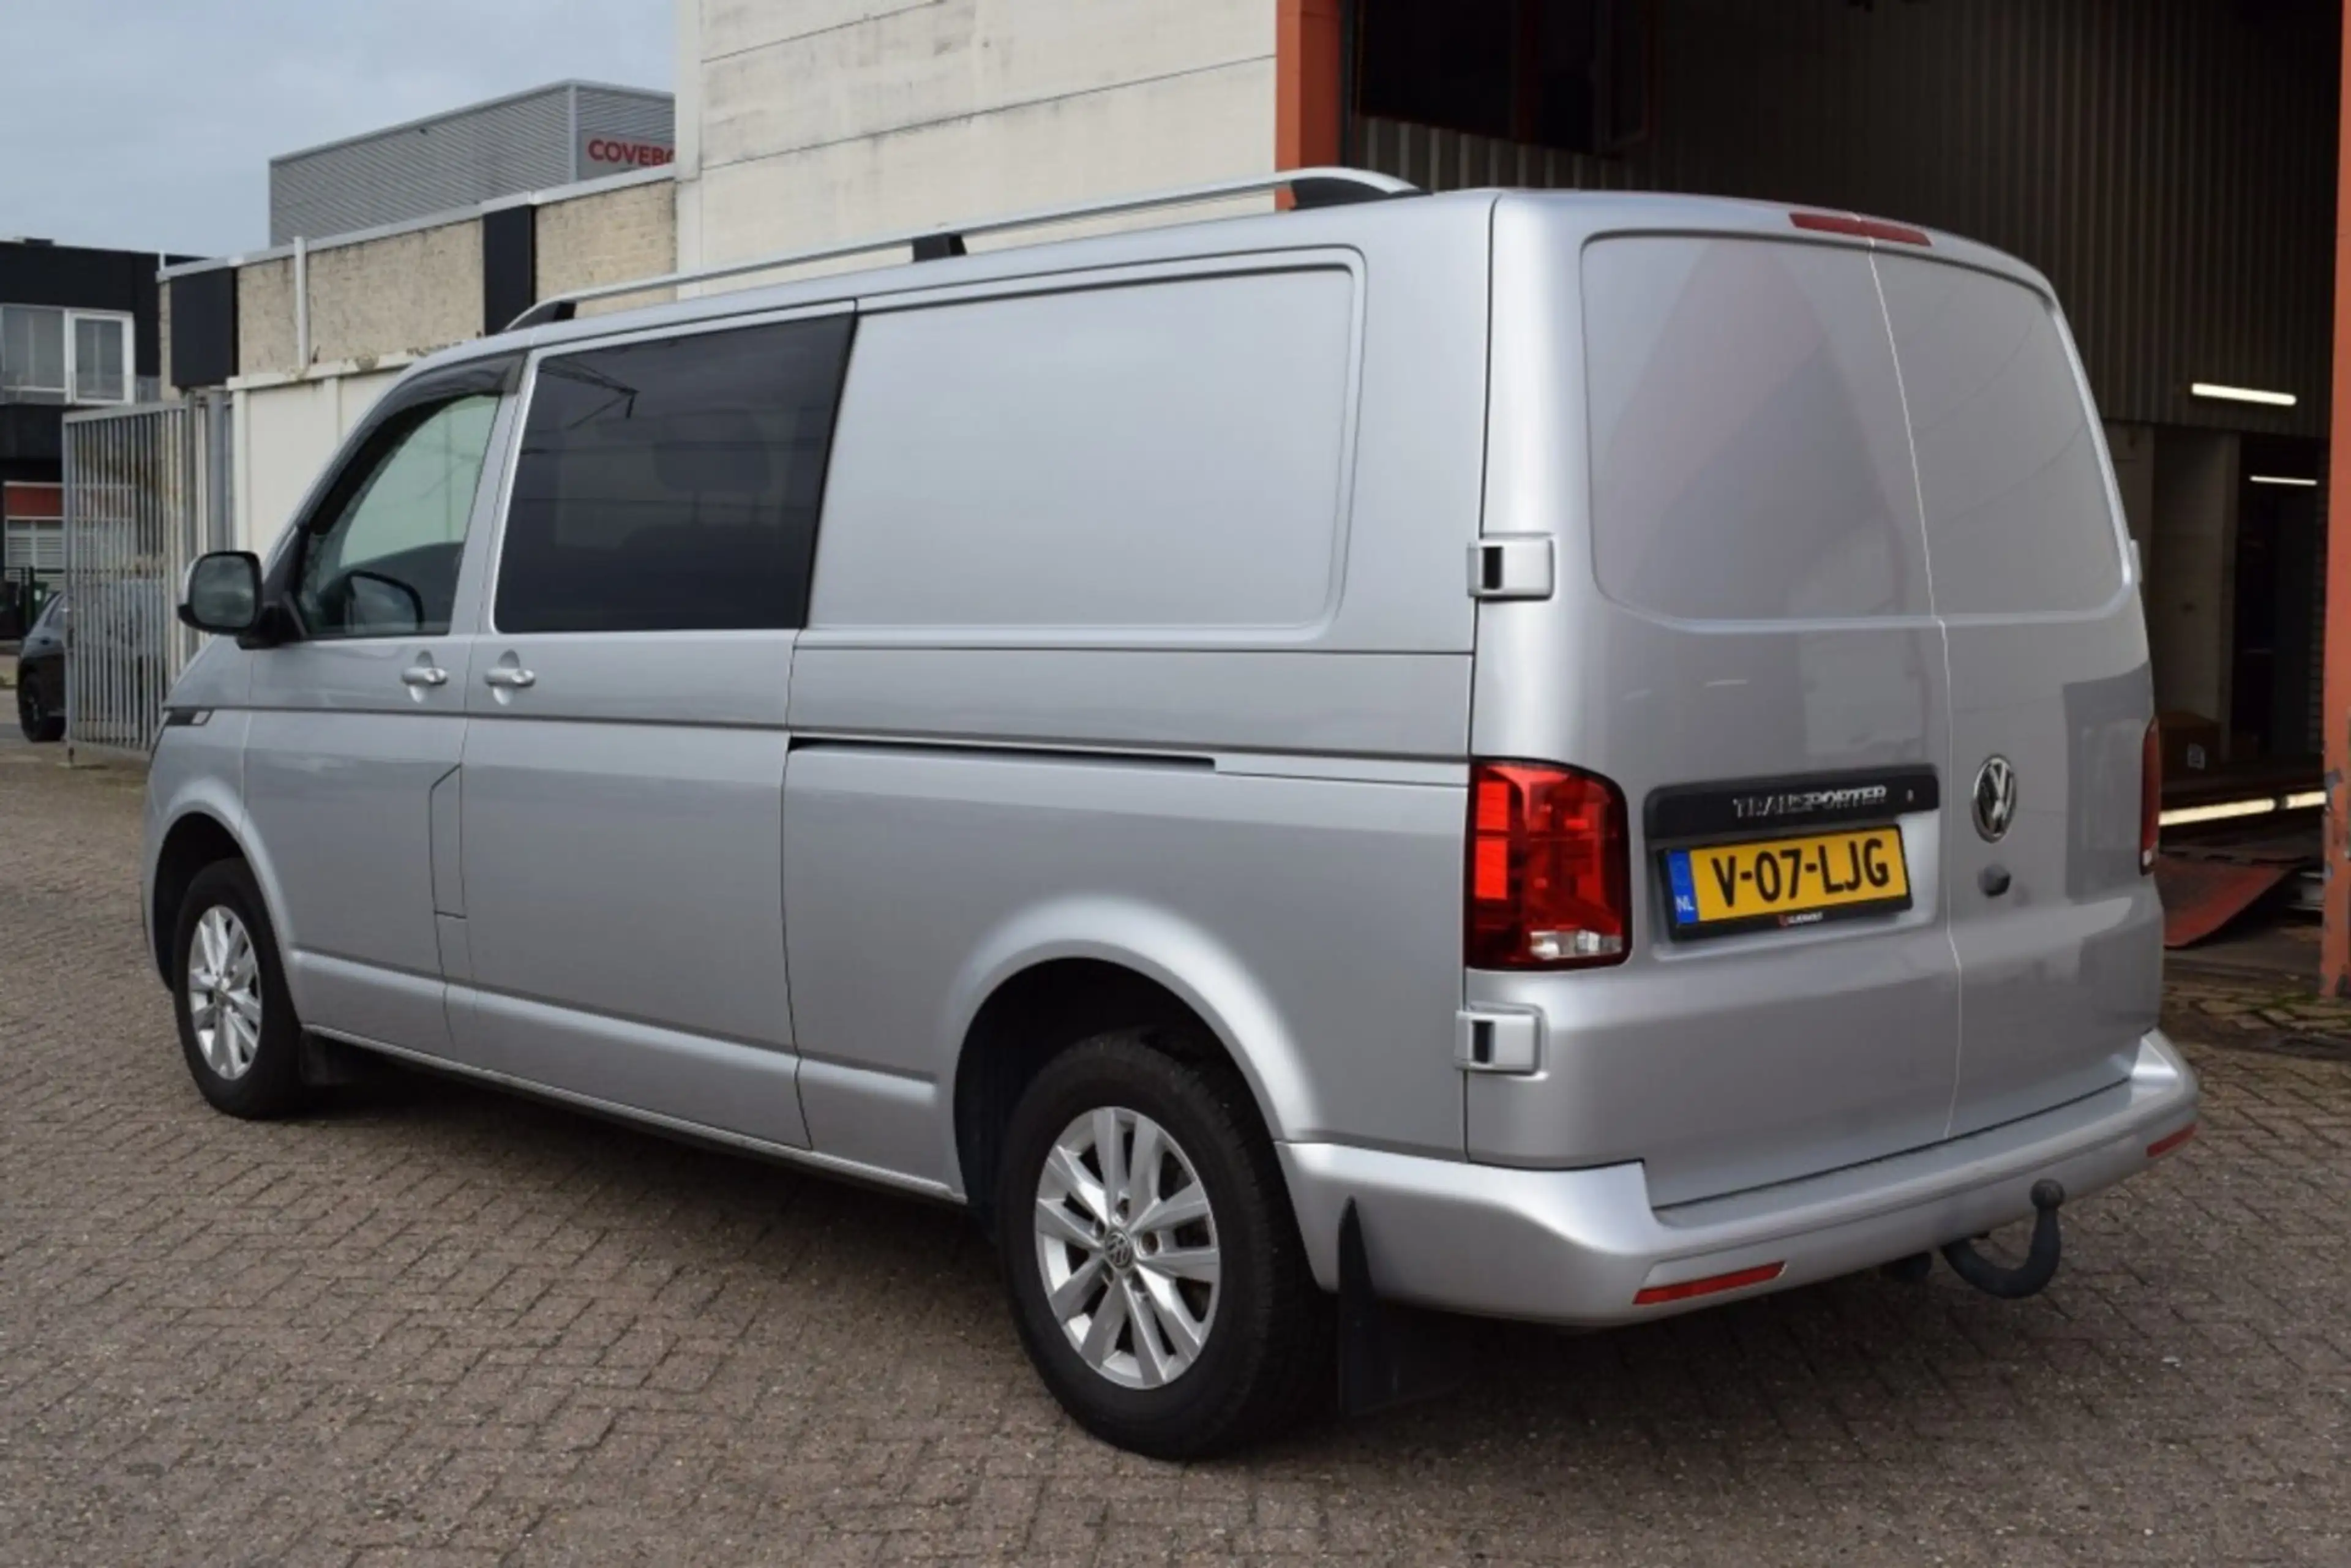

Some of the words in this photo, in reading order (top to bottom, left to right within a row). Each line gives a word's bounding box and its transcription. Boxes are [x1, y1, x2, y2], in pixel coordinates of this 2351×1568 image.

[1733, 785, 1887, 818] TRANSPORTER
[1711, 838, 1890, 908] V-07-LJG
[1675, 894, 1695, 913] NL
